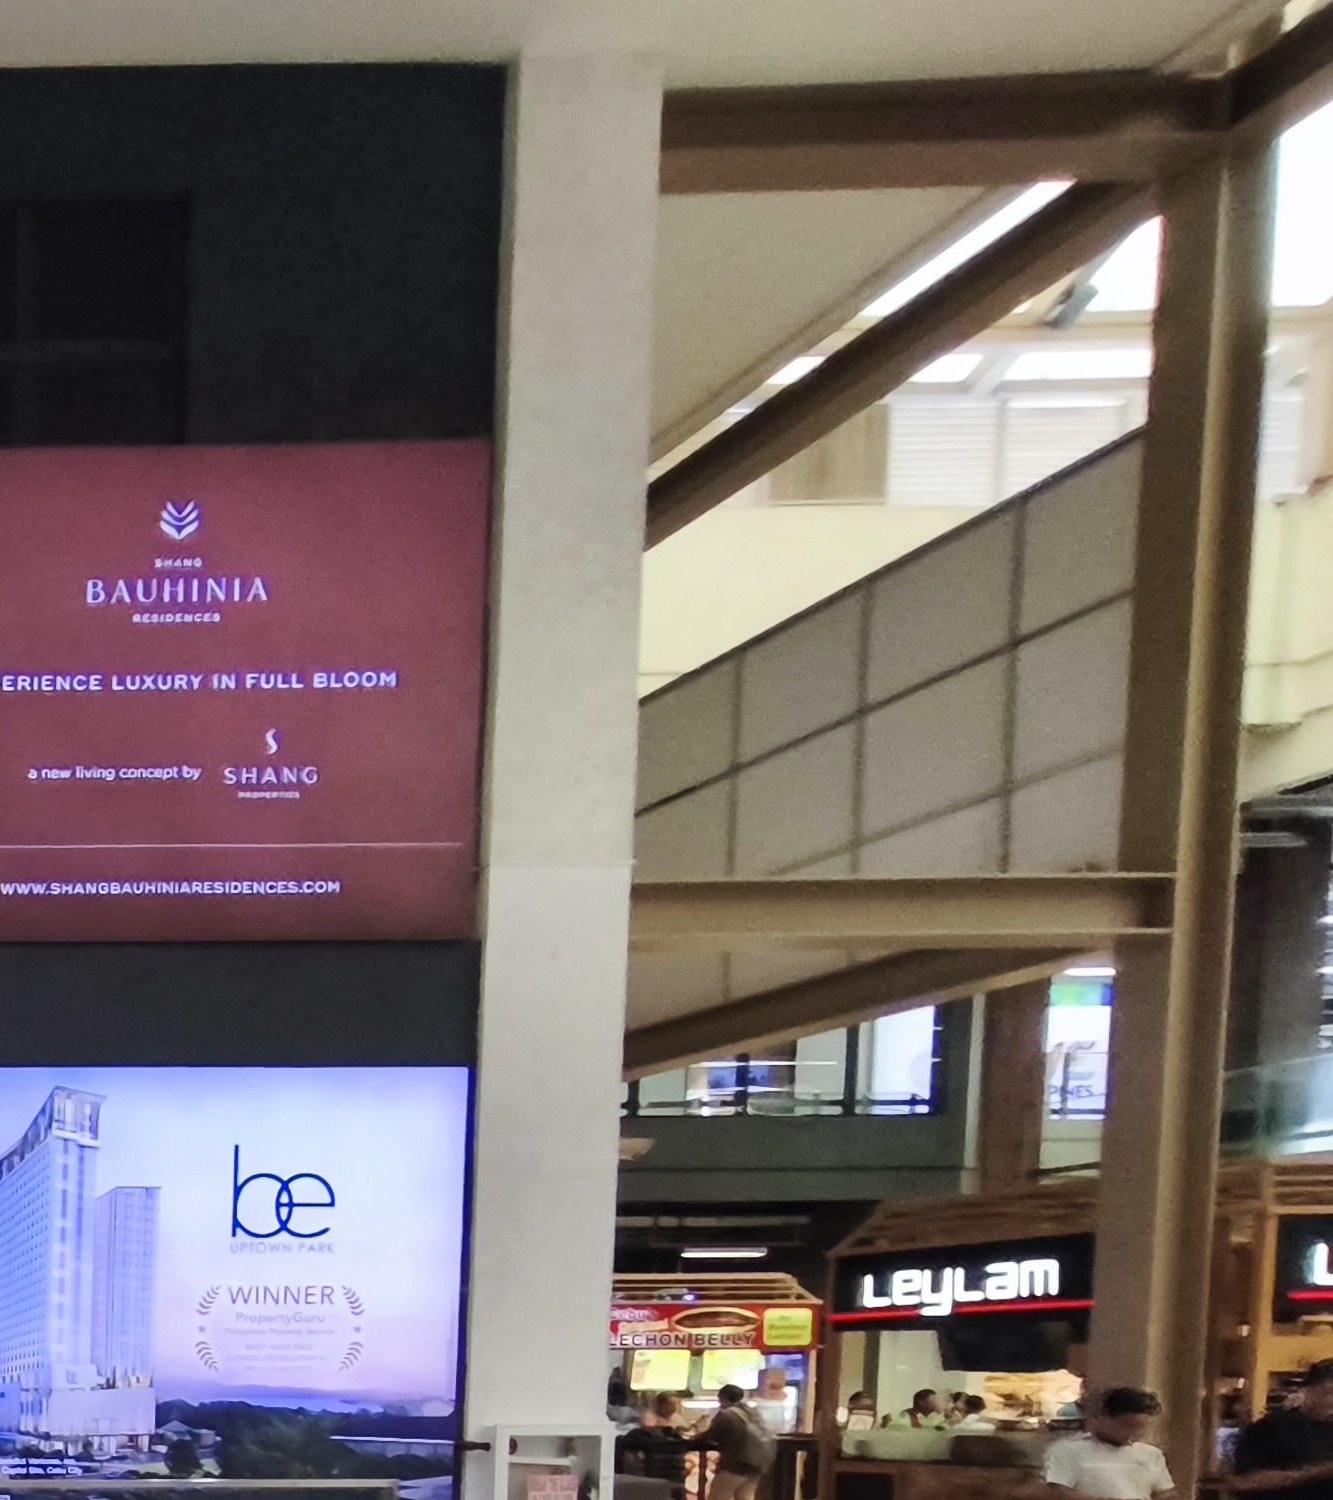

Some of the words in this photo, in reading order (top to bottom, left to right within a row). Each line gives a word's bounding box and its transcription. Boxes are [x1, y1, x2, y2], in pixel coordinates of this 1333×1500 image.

[85, 576, 269, 605] BAUHINIA
[132, 612, 221, 624] RESIDENCES
[111, 673, 204, 691] LUXURY
[212, 672, 236, 690] IN
[245, 671, 305, 689] FULL
[312, 670, 398, 688] BLOOM
[27, 767, 38, 780] a
[41, 768, 73, 780] new
[75, 765, 116, 781] living
[119, 766, 179, 781] concept
[182, 765, 202, 781] by
[223, 766, 319, 785] SHANG
[0, 880, 341, 896] WWW.SHANGBAUHINIARESIDENCES.COM
[231, 1144, 336, 1238] be
[229, 1241, 293, 1254] UPTOWN
[297, 1241, 335, 1254] PARK
[227, 1285, 335, 1305] WINNER
[235, 1311, 325, 1325] PropertyGuru
[694, 1331, 757, 1347] BELLY
